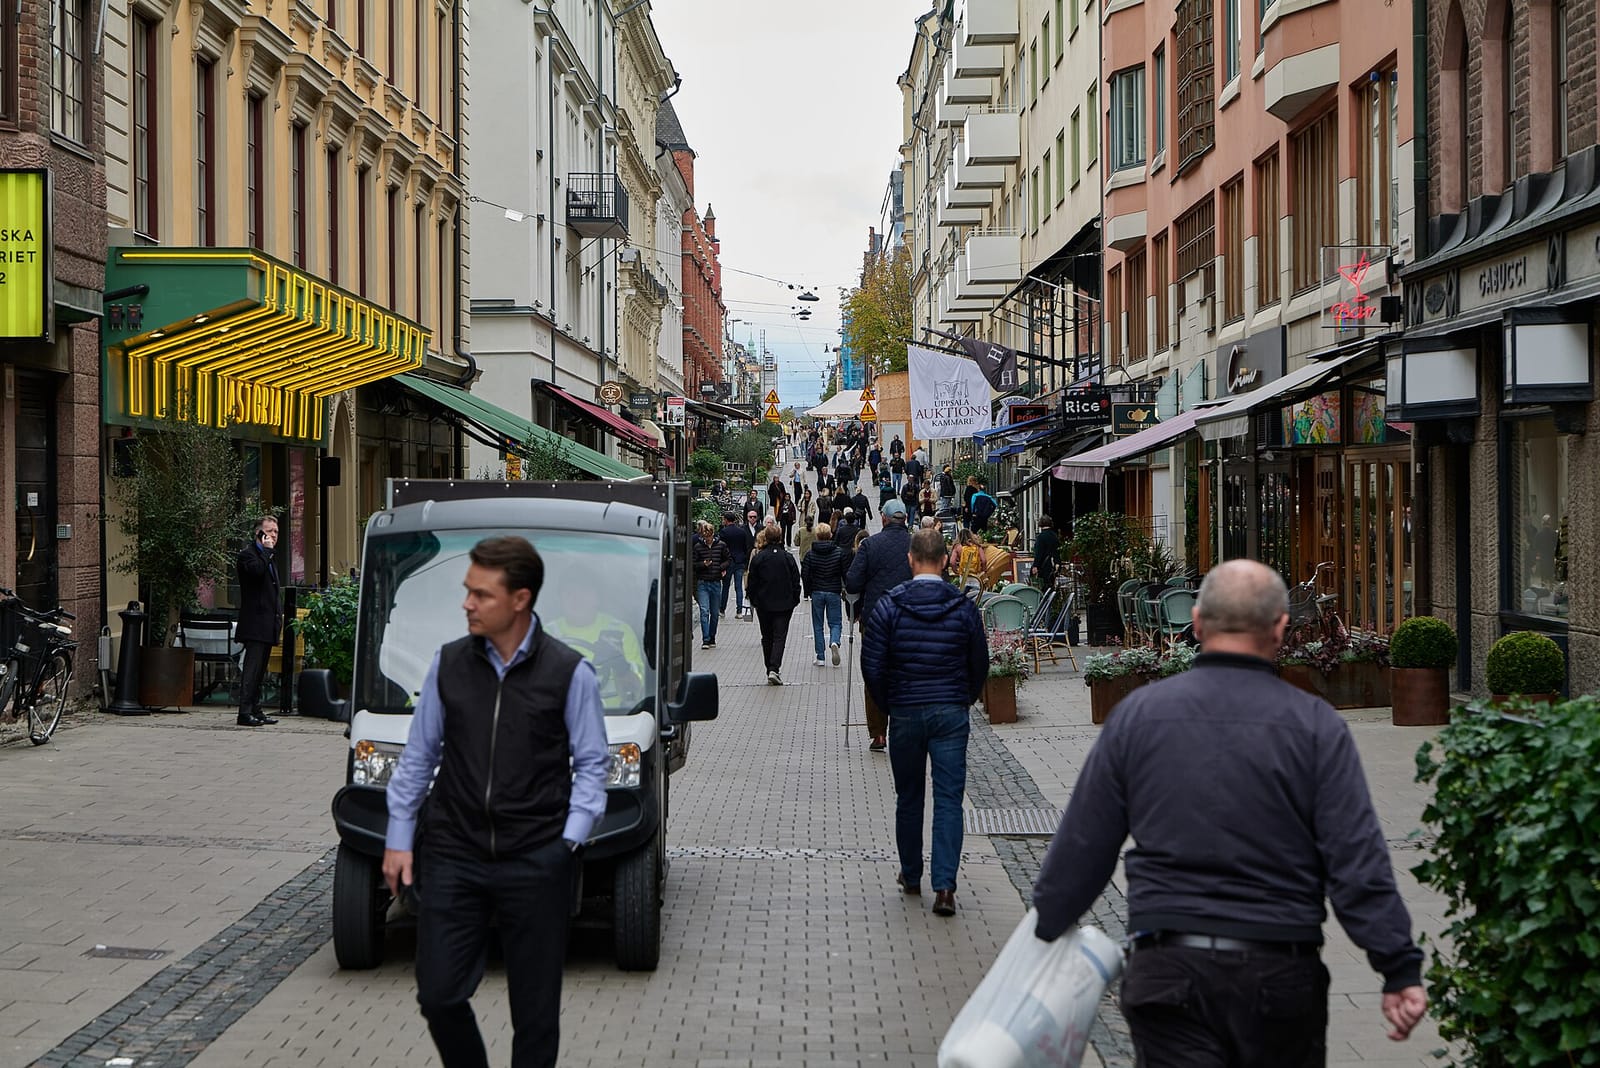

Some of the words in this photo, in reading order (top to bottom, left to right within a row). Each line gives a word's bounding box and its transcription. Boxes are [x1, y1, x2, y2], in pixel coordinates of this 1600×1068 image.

[1, 229, 34, 241] SKA
[1329, 302, 1376, 319] Bar
[987, 345, 1004, 364] H
[1000, 369, 1015, 387] H
[227, 379, 281, 426] ASTORIA
[934, 399, 970, 407] UPPSALA
[1065, 400, 1100, 413] Rice
[915, 405, 989, 420] AUKTIONS
[931, 418, 975, 427] KAMMARE
